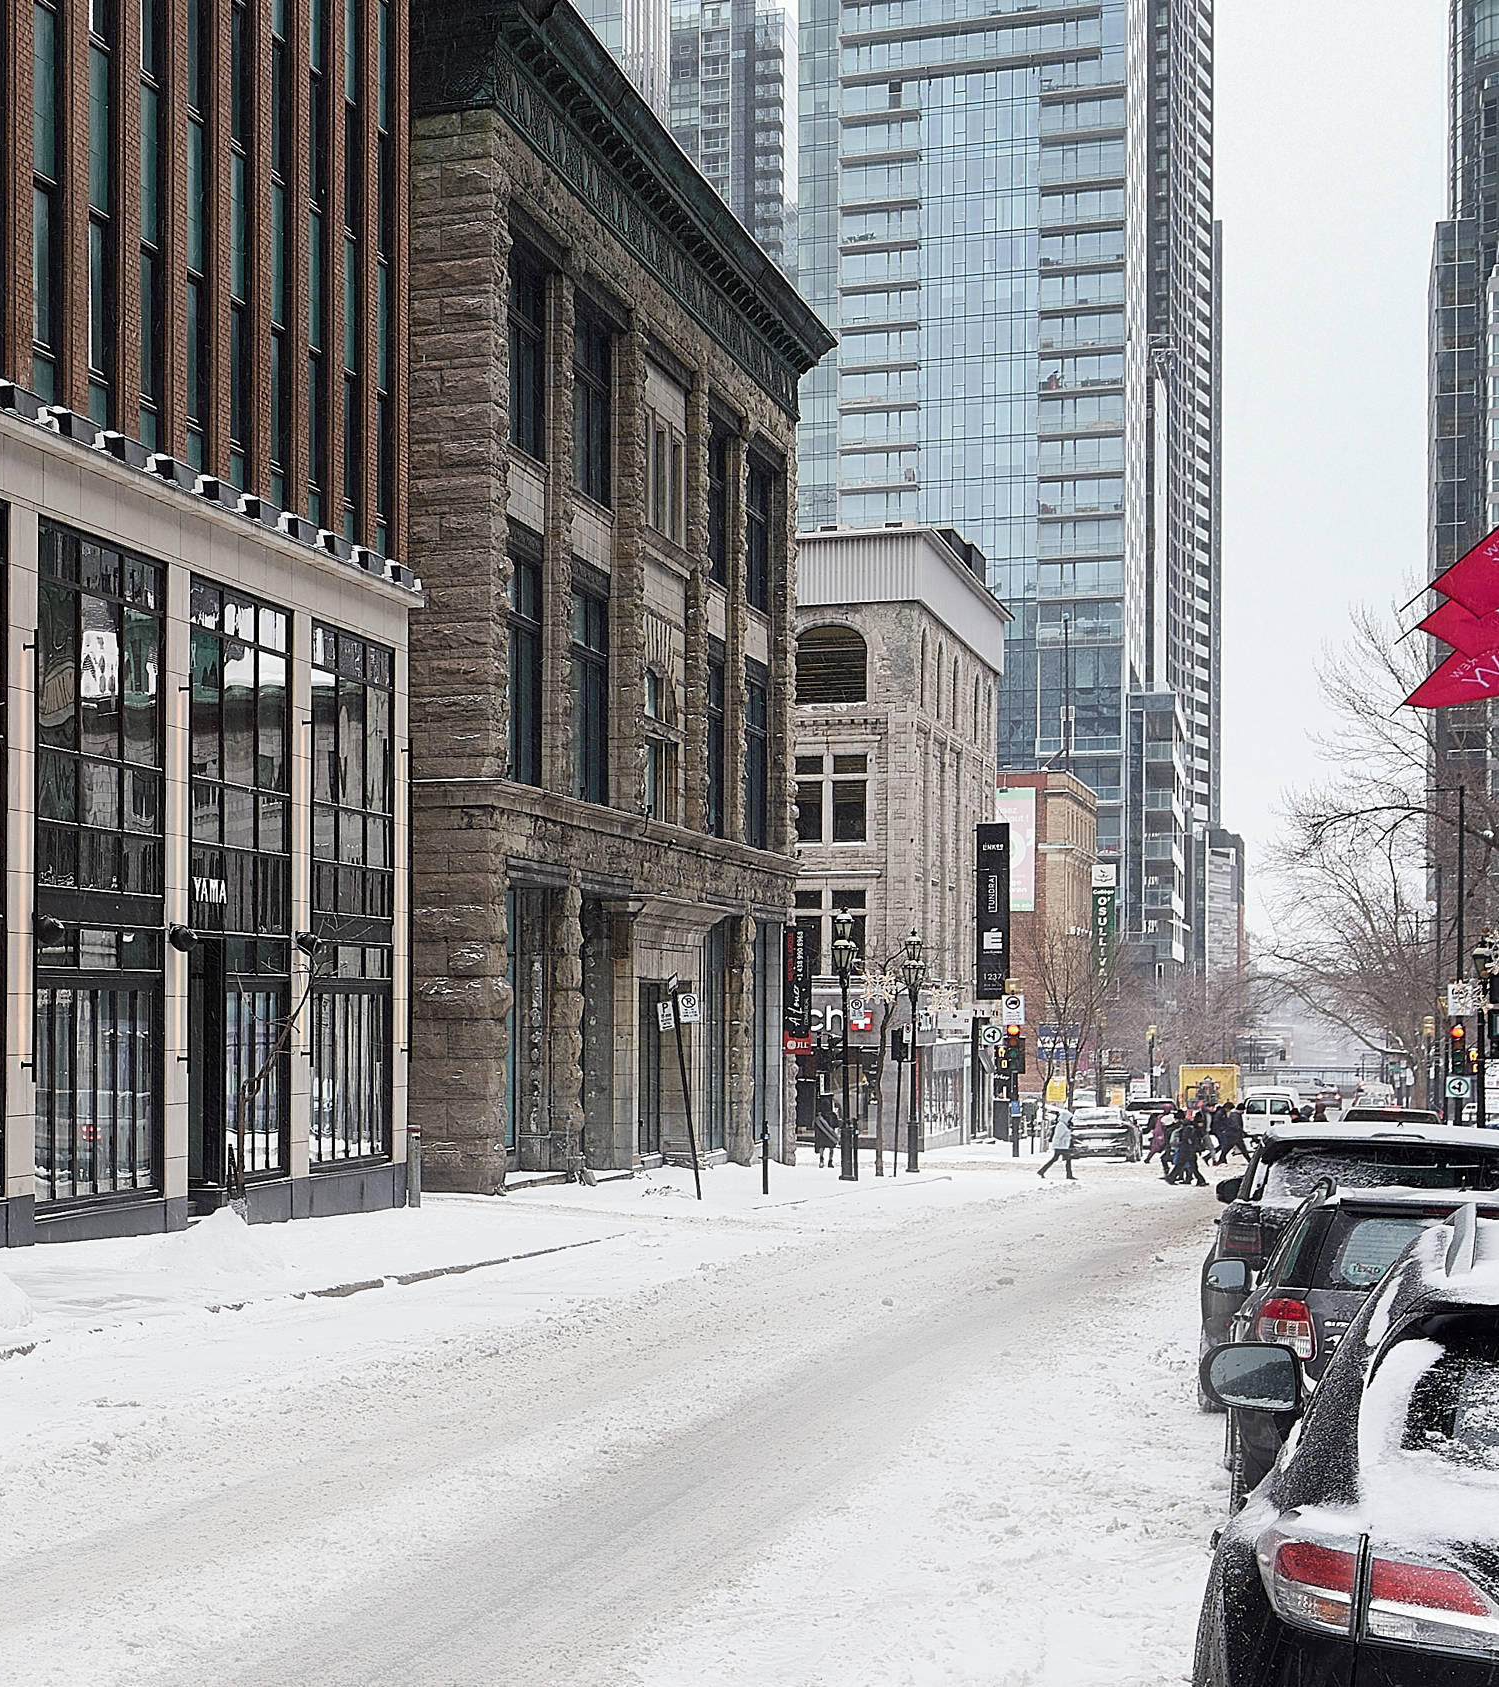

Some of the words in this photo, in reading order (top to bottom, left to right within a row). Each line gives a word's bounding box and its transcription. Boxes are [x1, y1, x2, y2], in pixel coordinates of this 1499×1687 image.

[191, 876, 227, 904] YAMA
[983, 973, 1002, 981] 1237
[662, 1003, 669, 1013] P
[796, 1041, 809, 1049] JLL
